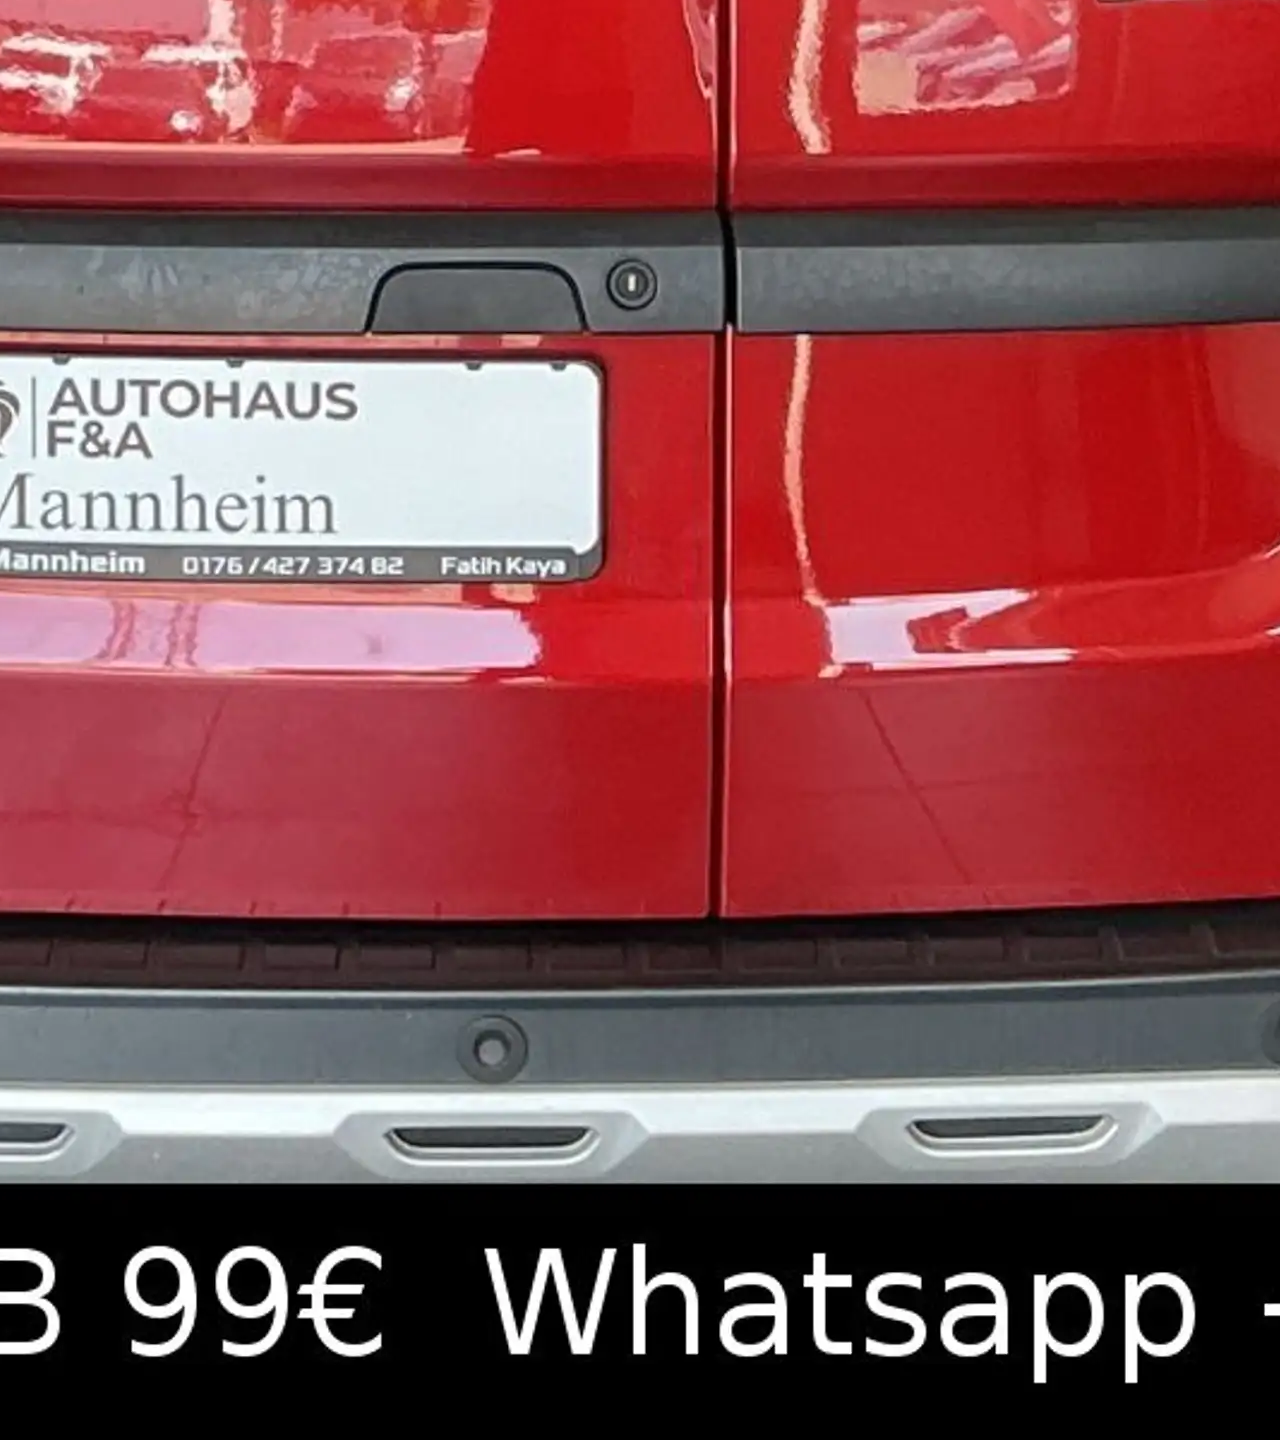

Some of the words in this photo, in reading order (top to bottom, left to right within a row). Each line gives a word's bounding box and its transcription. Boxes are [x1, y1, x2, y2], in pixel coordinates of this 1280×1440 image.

[47, 378, 360, 421] AUTOHAUS
[46, 420, 153, 459] F&A
[440, 556, 502, 575] Fatih
[505, 556, 567, 579] Kaya
